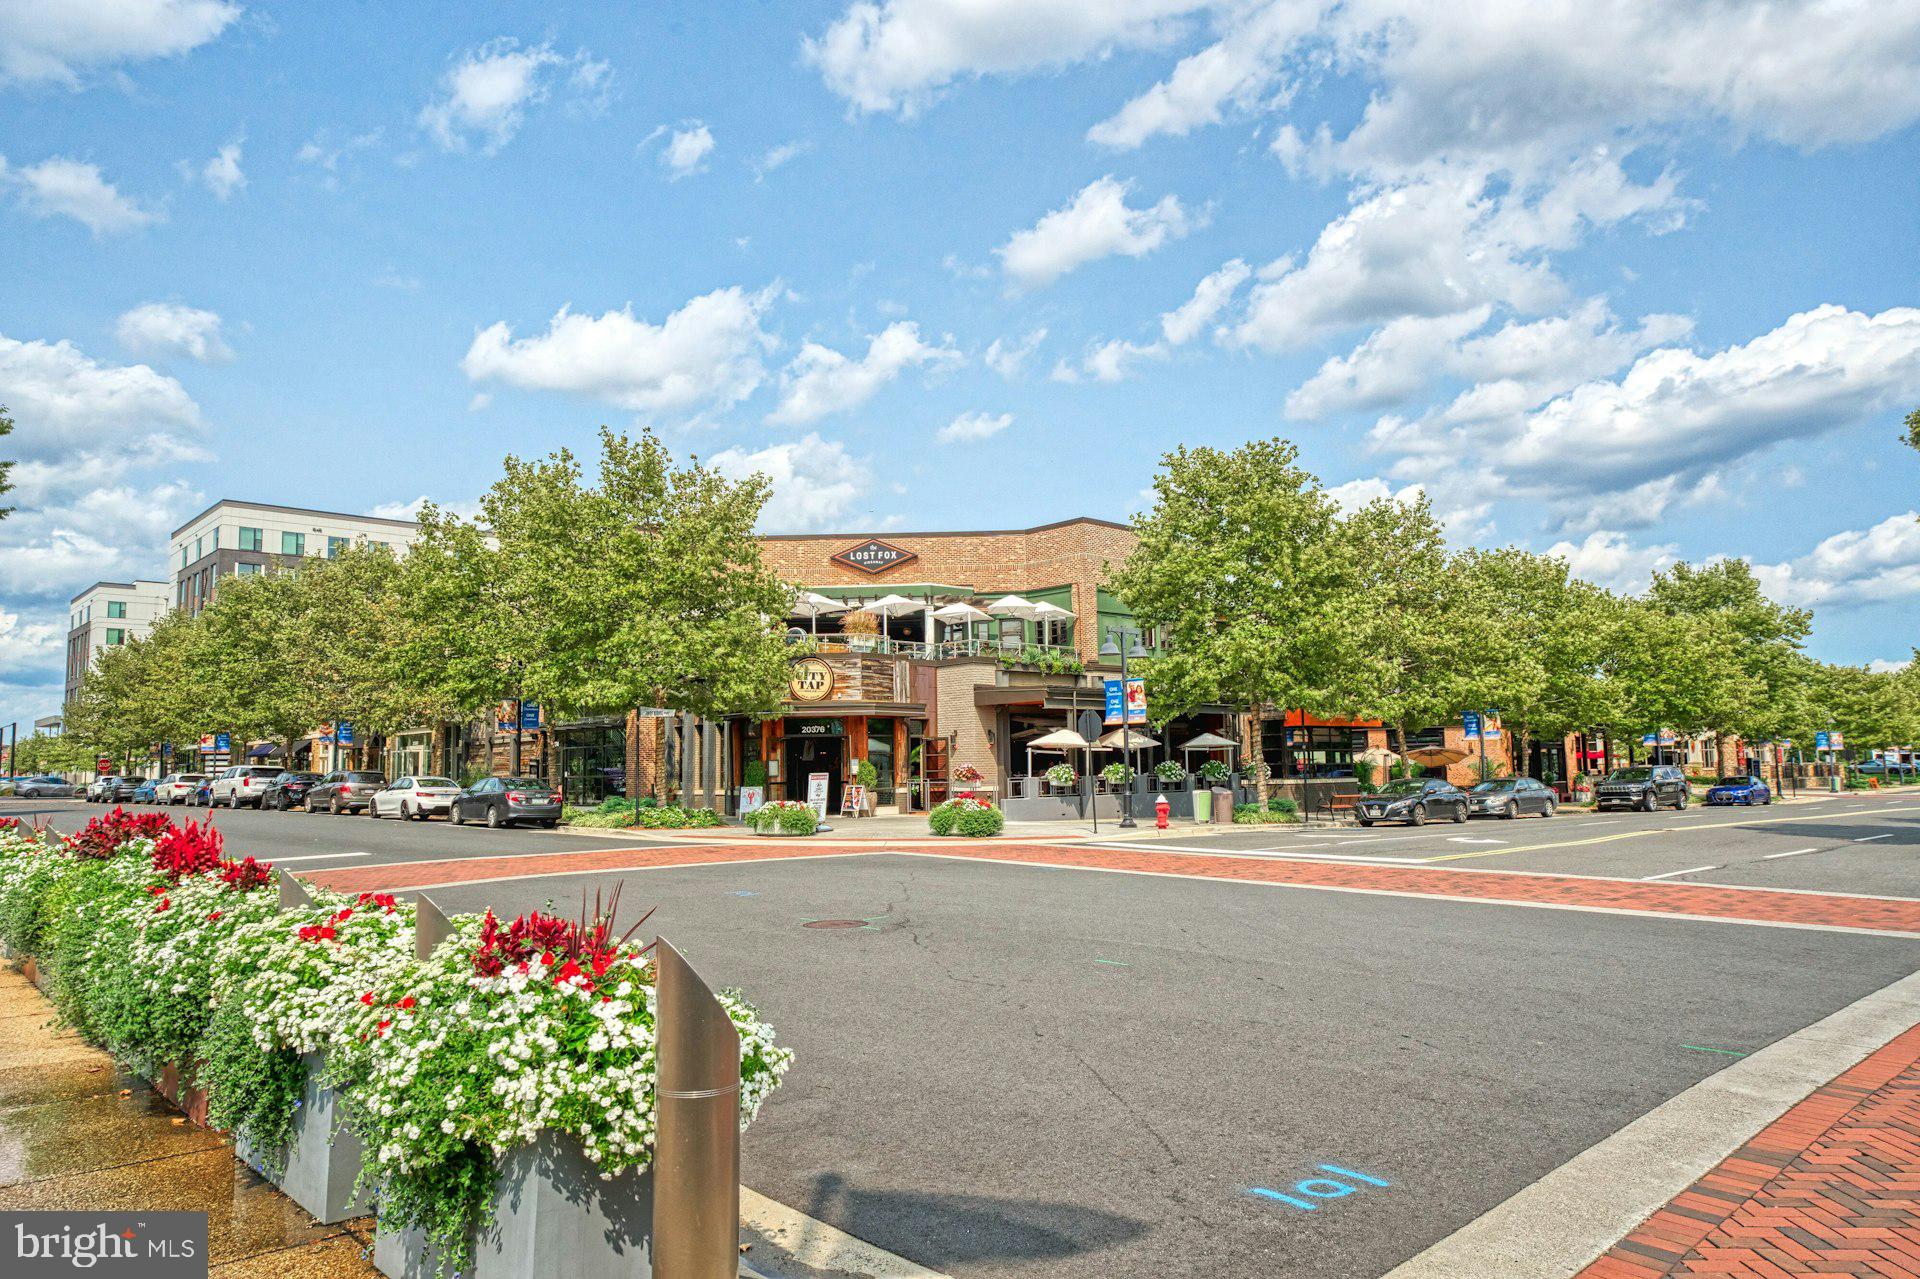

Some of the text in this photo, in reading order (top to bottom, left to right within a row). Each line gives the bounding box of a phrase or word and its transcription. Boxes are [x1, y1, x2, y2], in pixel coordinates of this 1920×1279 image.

[850, 551, 897, 560] LOST FOX
[798, 681, 825, 690] TAP
